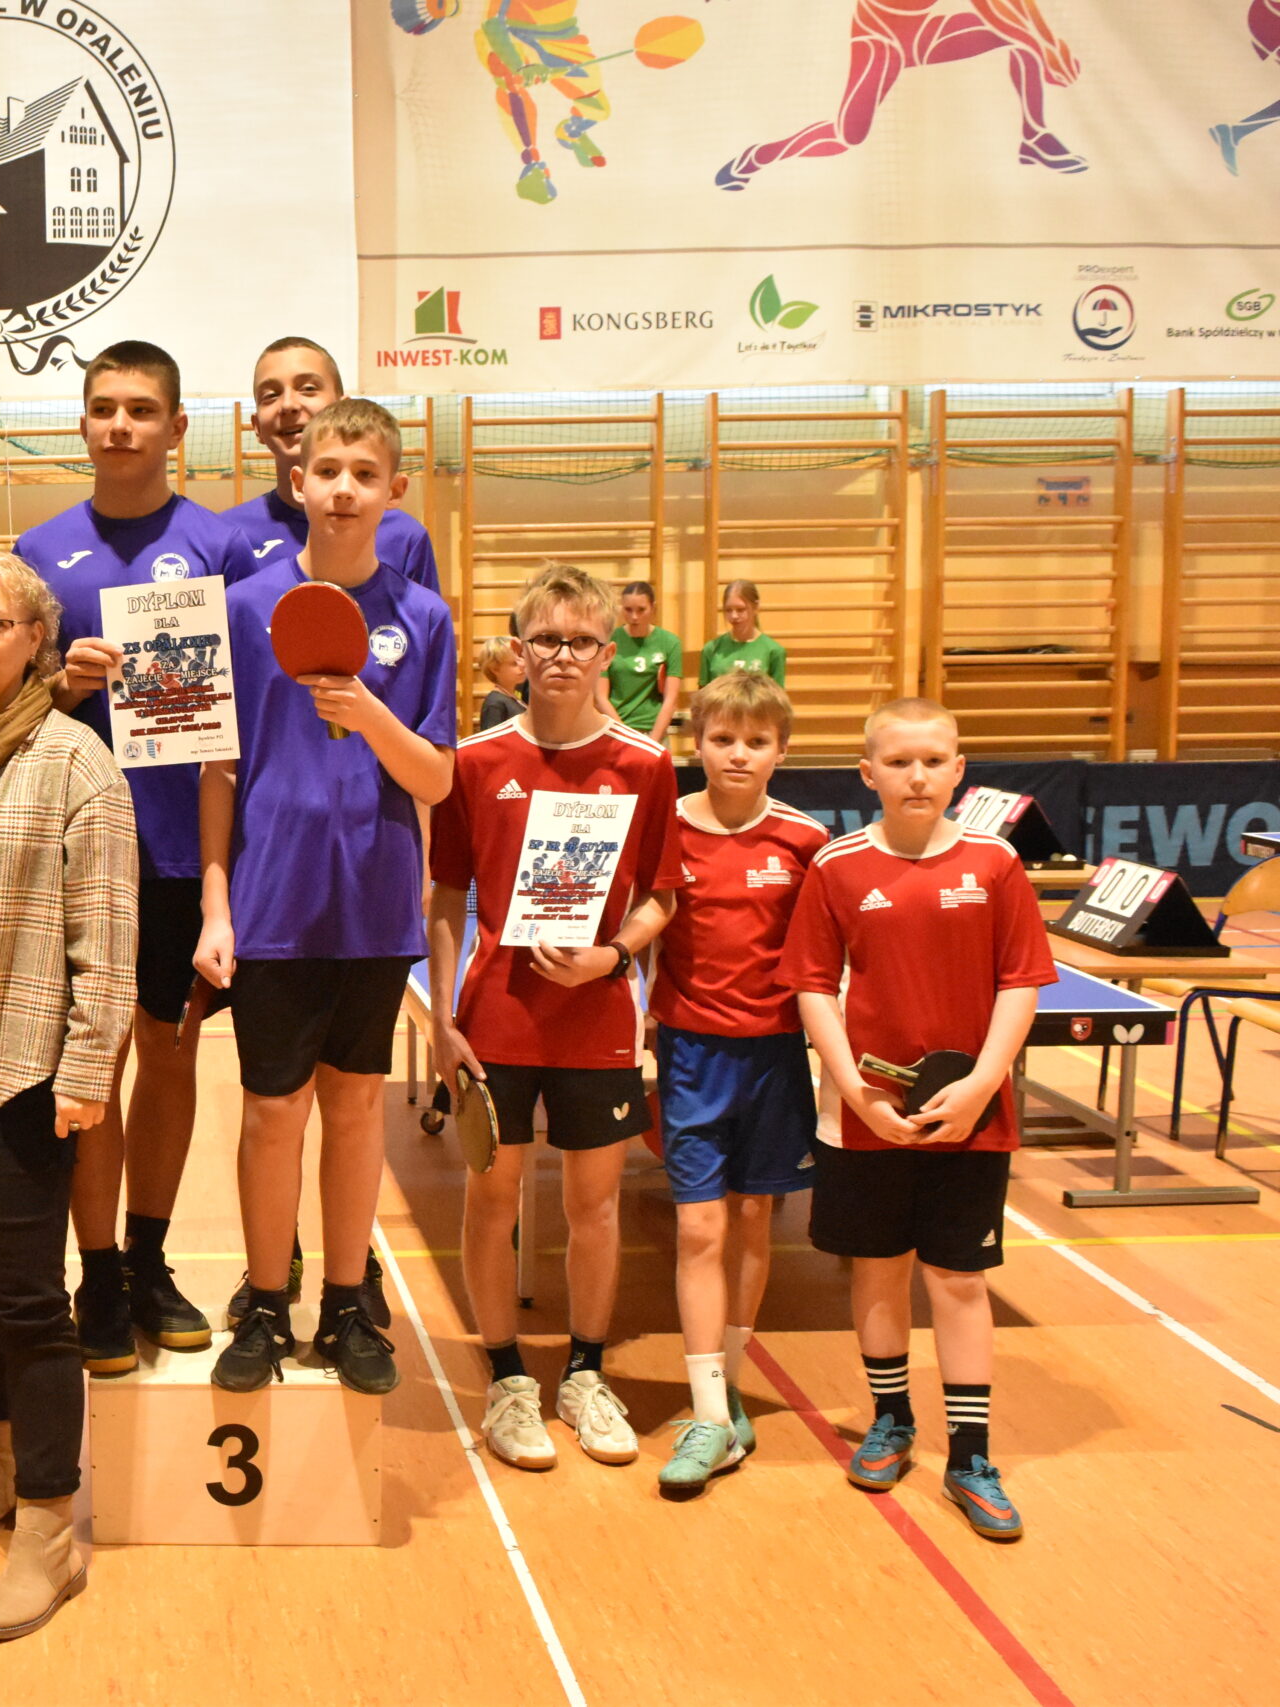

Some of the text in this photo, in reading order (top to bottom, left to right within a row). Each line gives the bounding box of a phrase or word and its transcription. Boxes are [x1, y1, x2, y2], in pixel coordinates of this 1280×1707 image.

[56, 8, 164, 141] OPALENIU
[883, 304, 1042, 318] MIKROSTYK
[1236, 301, 1261, 311] SGB
[572, 311, 714, 332] KONGSBERG
[1166, 327, 1195, 337] Bank
[376, 348, 508, 367] INWEST-KOM
[127, 589, 206, 614] DYPLOM
[154, 616, 180, 629] DLA
[634, 656, 646, 673] 3
[180, 668, 217, 680] MIEJSCE
[496, 791, 528, 800] adidas
[553, 801, 619, 818] DYPLOM
[571, 824, 591, 834] DLA
[1087, 802, 1280, 867] EWO
[859, 900, 893, 912] adidas
[1066, 910, 1127, 942] BUTTERFLY
[205, 1423, 263, 1507] 3
